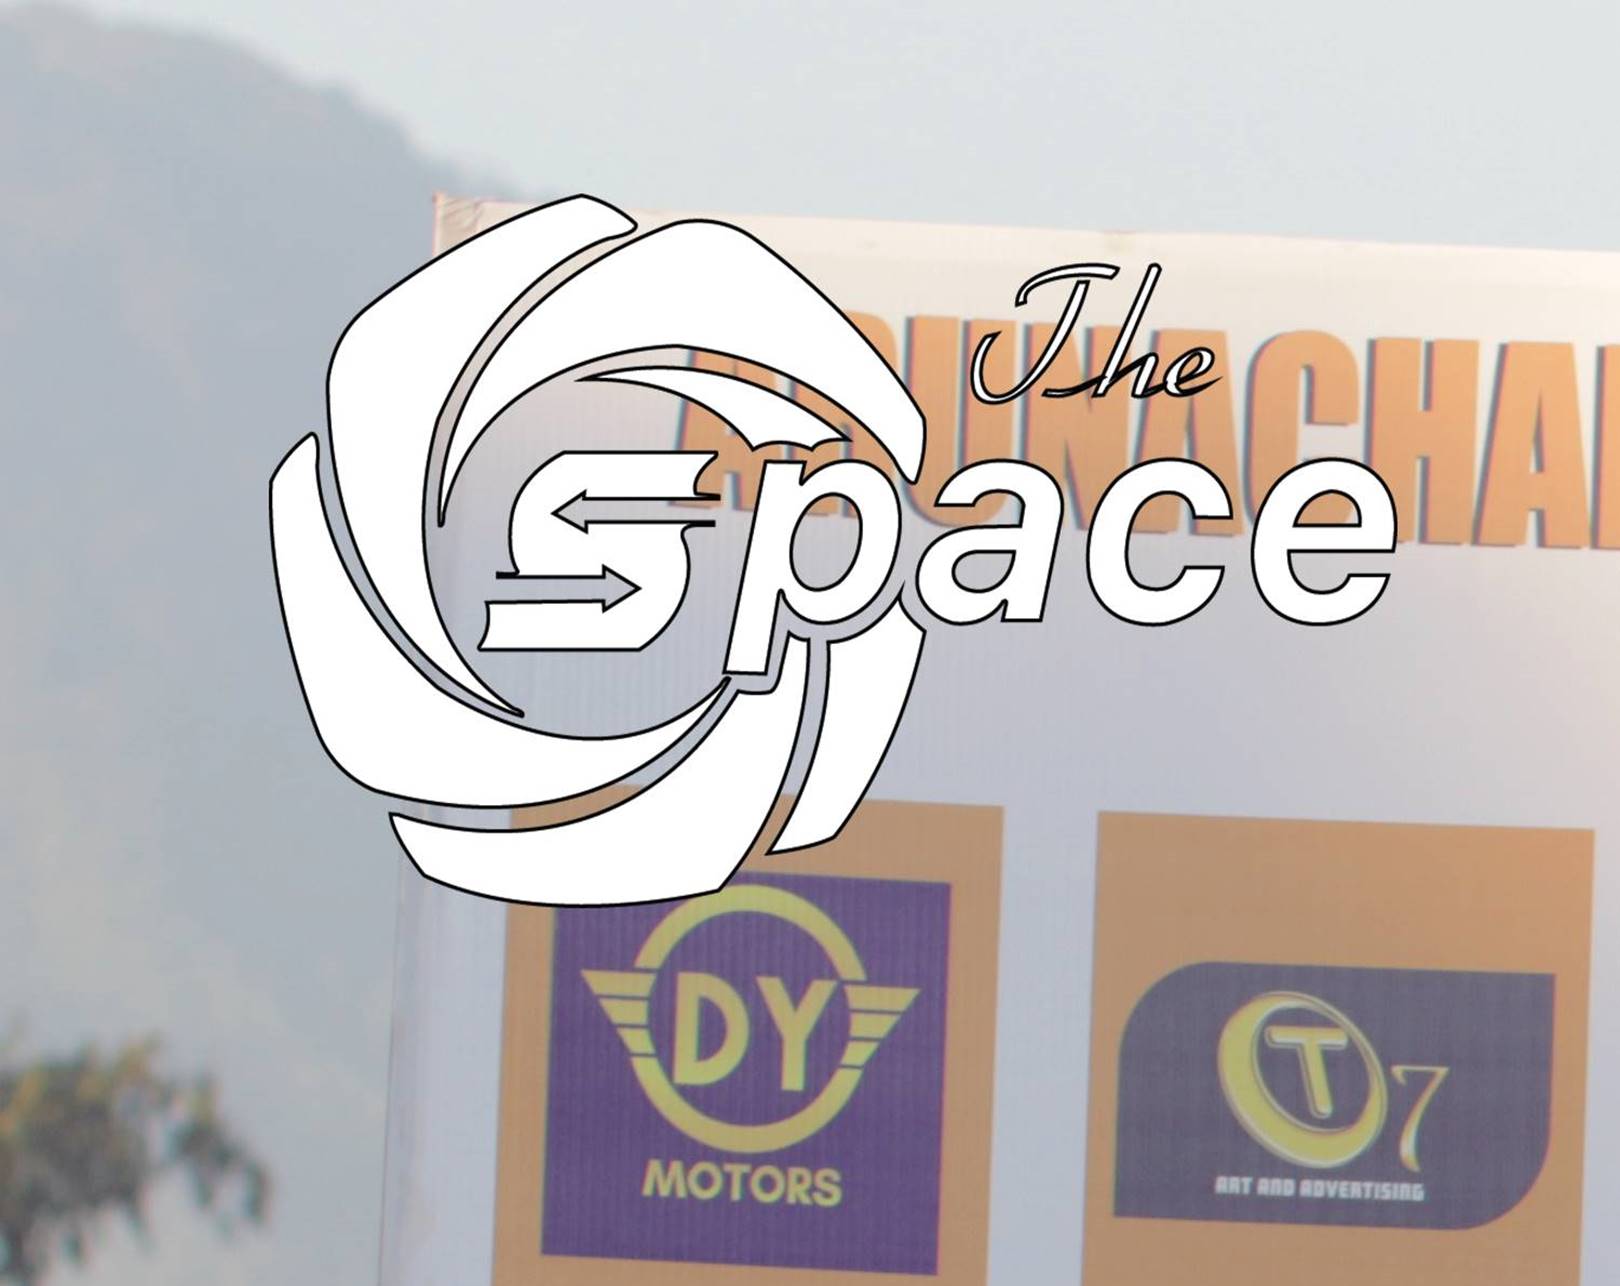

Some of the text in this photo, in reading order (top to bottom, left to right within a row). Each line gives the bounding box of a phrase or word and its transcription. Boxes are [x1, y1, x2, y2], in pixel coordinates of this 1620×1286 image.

[673, 971, 838, 1091] DY
[642, 1159, 843, 1207] MOTORS
[1215, 1176, 1425, 1202] ART AND ADVERTISING
